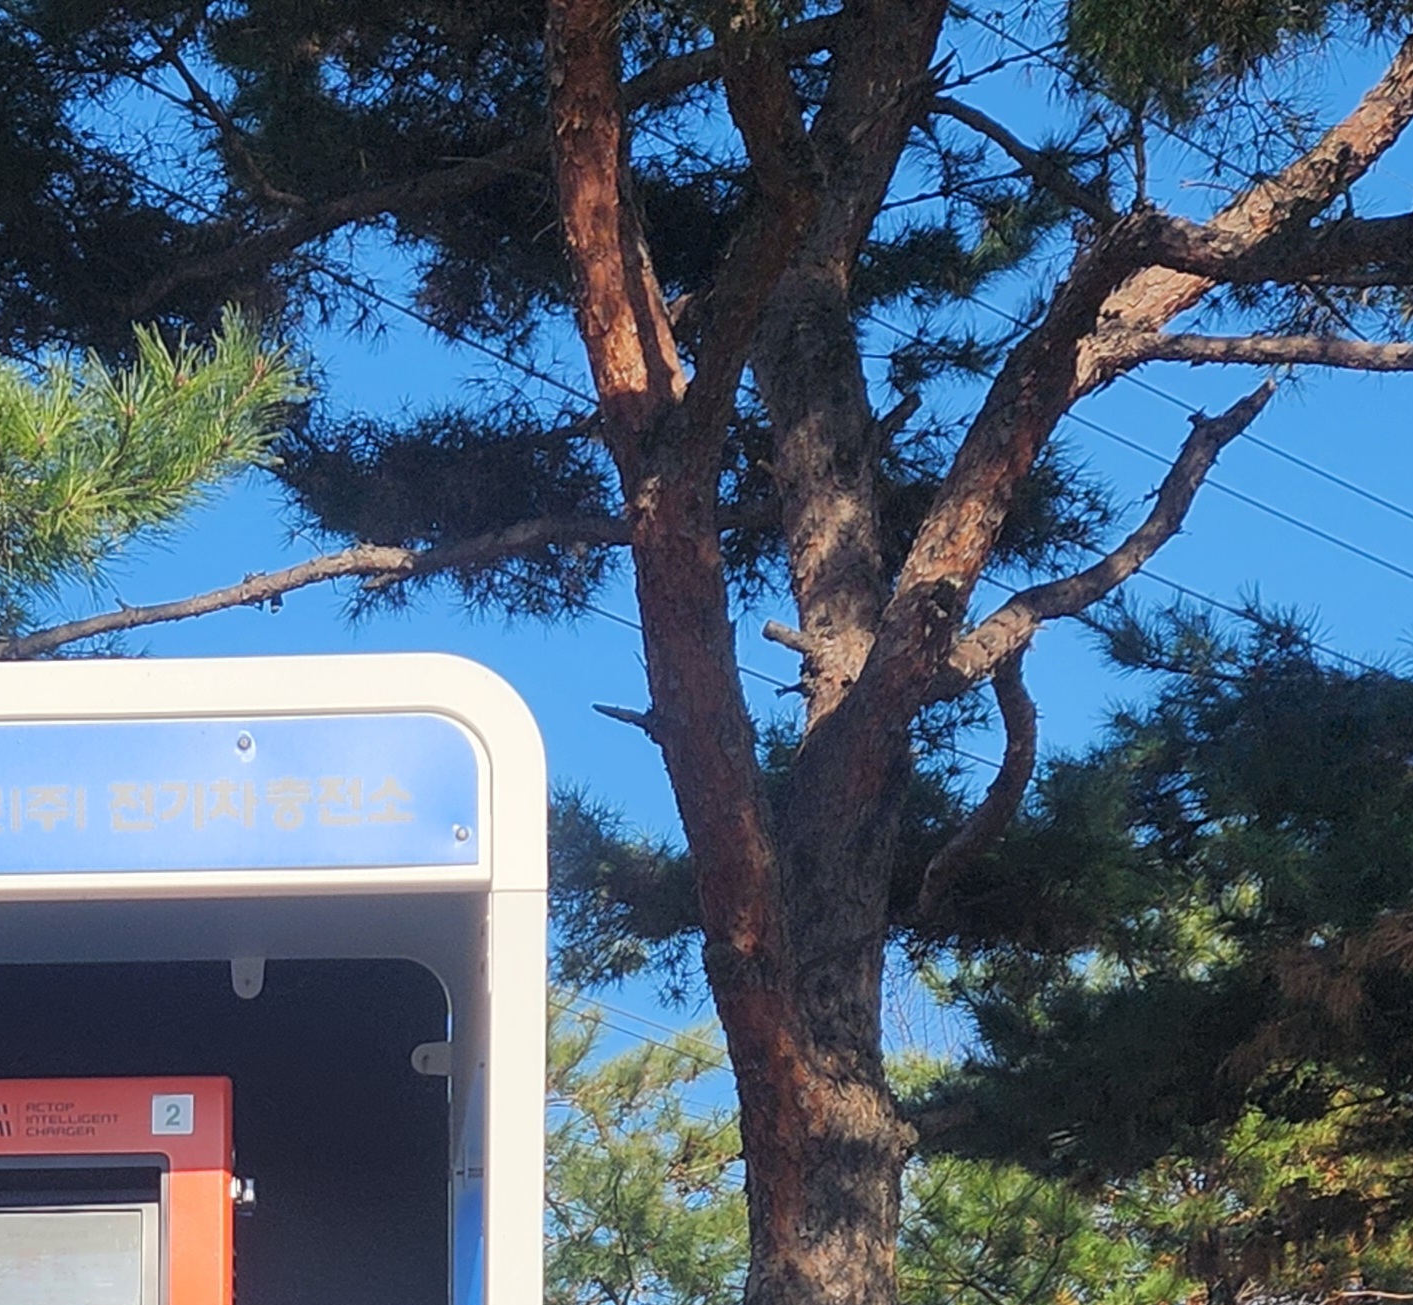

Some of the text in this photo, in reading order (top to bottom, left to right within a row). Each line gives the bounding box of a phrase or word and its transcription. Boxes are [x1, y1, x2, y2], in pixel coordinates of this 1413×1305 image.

[109, 776, 415, 832] 전기차충전소
[25, 1102, 75, 1112] ACTOP
[25, 1113, 119, 1124] INTELLIGENT
[165, 1103, 182, 1126] 2
[25, 1126, 96, 1137] CHARGER
